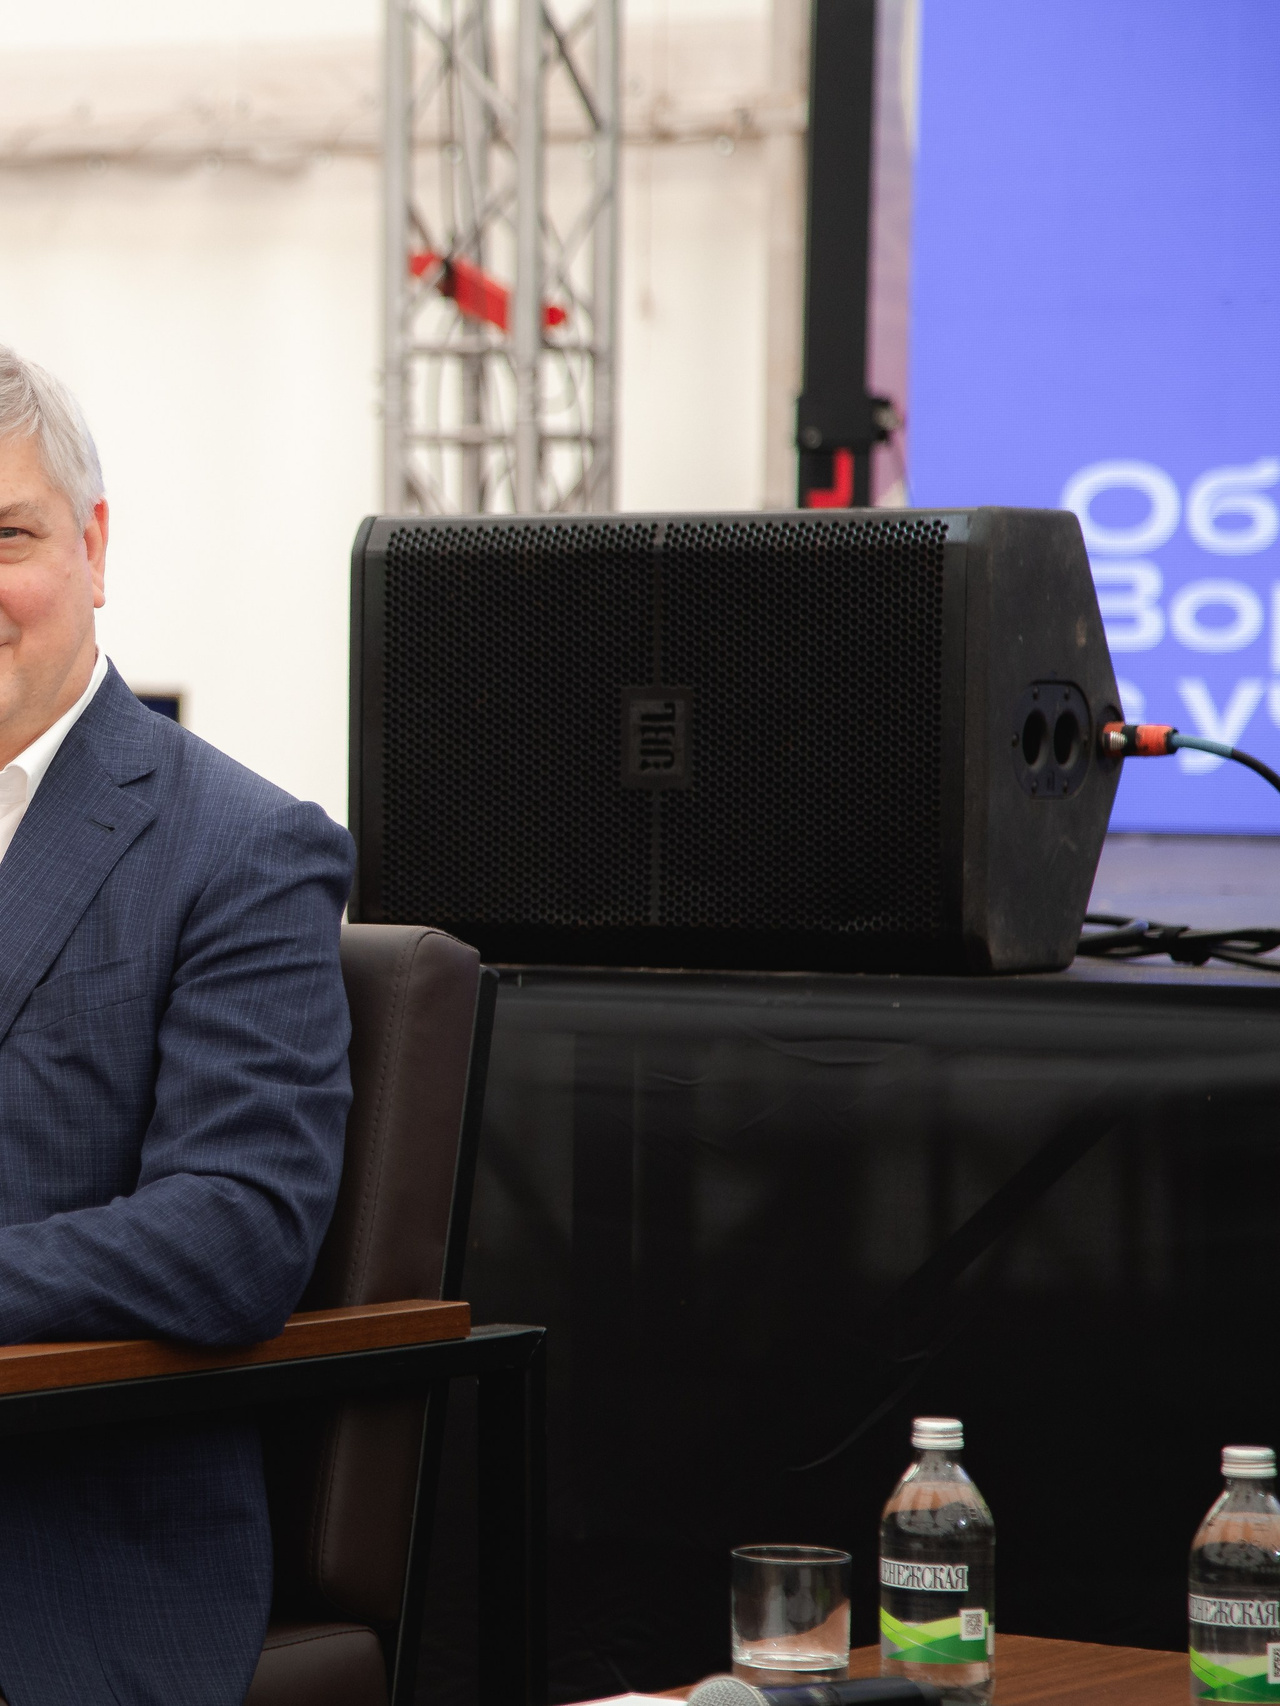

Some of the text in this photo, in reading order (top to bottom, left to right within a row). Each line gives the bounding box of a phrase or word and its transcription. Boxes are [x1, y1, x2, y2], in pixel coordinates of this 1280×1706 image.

[1062, 456, 1280, 556] Об
[1089, 558, 1280, 675] Во
[640, 702, 676, 771] JBL
[880, 1559, 967, 1590] ЕНЕЖСКАЯ
